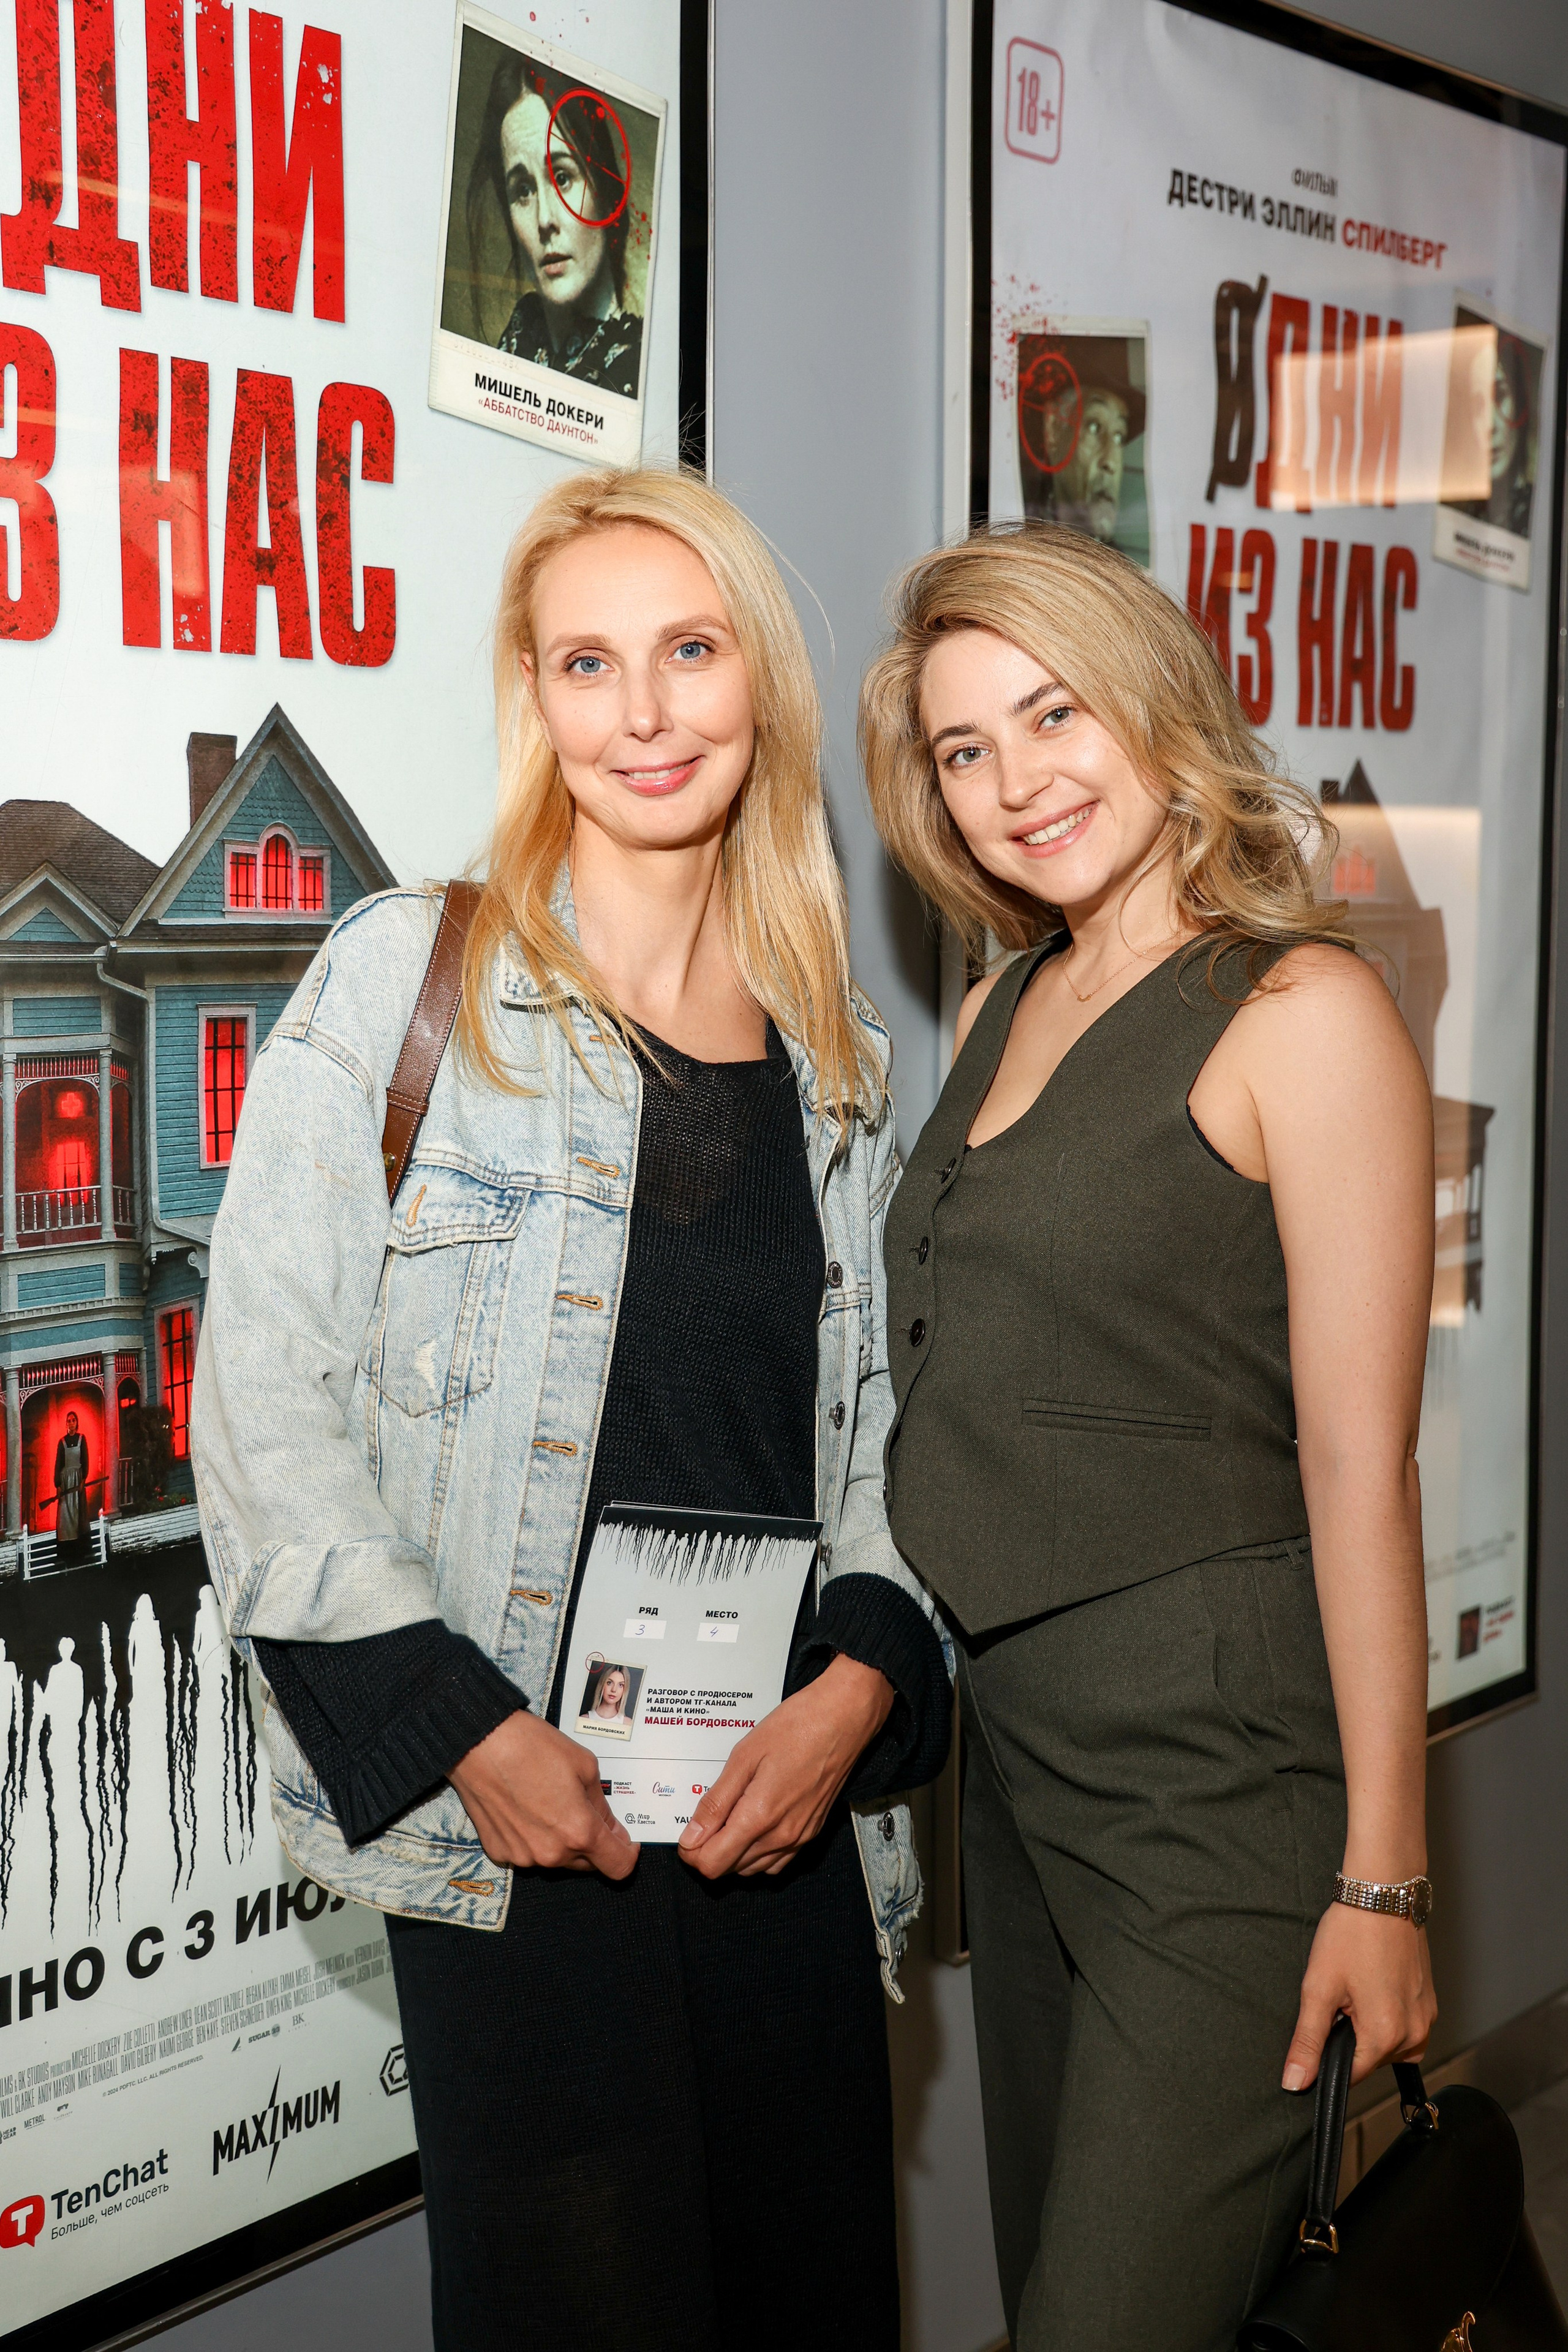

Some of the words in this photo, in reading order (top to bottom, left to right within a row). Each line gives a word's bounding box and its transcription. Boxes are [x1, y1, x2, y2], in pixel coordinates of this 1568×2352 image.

[1017, 67, 1056, 136] 18+
[1167, 168, 1256, 222] ДЕСТРИ
[1261, 196, 1336, 244] ЭЛЛИН
[1342, 218, 1448, 271] СПИЛБЕРГ
[475, 372, 541, 407] МИШЕЛЬ
[546, 398, 605, 430] ДОКЕРИ
[478, 397, 545, 428] «АББАТСТВО
[547, 419, 598, 445] ДАУНТОН»
[119, 347, 397, 668] НАС
[1187, 523, 1277, 727] ИЗ
[1297, 536, 1419, 733] НАС
[635, 1624, 646, 1635] 3
[709, 1626, 719, 1637] 4
[639, 1607, 658, 1616] РЯД
[706, 1610, 738, 1619] МЕСТО
[644, 1716, 684, 1725] МАШЕЙ
[687, 1717, 755, 1728] БОРДОВСКИХ
[0, 1946, 105, 2028] НО
[126, 1926, 164, 1979] С
[184, 1910, 215, 1959] 3
[18, 2069, 26, 2091] BK
[28, 2060, 49, 2087] STUDIOS
[72, 2043, 96, 2071] MICHELLE
[97, 2034, 121, 2062] DOCKERY
[124, 2030, 132, 2052] ZOE
[134, 2022, 156, 2048] COLLETTI
[158, 2013, 178, 2039] ANDREW
[195, 2003, 207, 2025] DEAN
[208, 1997, 222, 2020] SCOTT
[248, 2030, 271, 2043] SUGAR
[292, 2013, 305, 2026] BK
[0, 2095, 13, 2119] WILL
[15, 2087, 35, 2114] CLARKE
[38, 2081, 53, 2105] ANDY
[54, 2073, 75, 2099] MAYSON
[78, 2067, 91, 2090] MIKE
[93, 2057, 118, 2084] RUNAGALL
[121, 2050, 136, 2073] DAVID
[159, 2035, 175, 2059] NAOMI
[176, 2029, 194, 2052] GEORGE
[196, 2024, 206, 2045] BEN
[207, 2019, 219, 2041] KAYE
[221, 2012, 239, 2036] STEVEN
[159, 2065, 177, 2076] RIGHTS
[213, 2064, 341, 2184] MAXIMUM
[51, 2148, 168, 2220] TenChat
[51, 2214, 97, 2240] Больше,
[101, 2202, 123, 2217] чем
[126, 2183, 170, 2208] соцсеть
